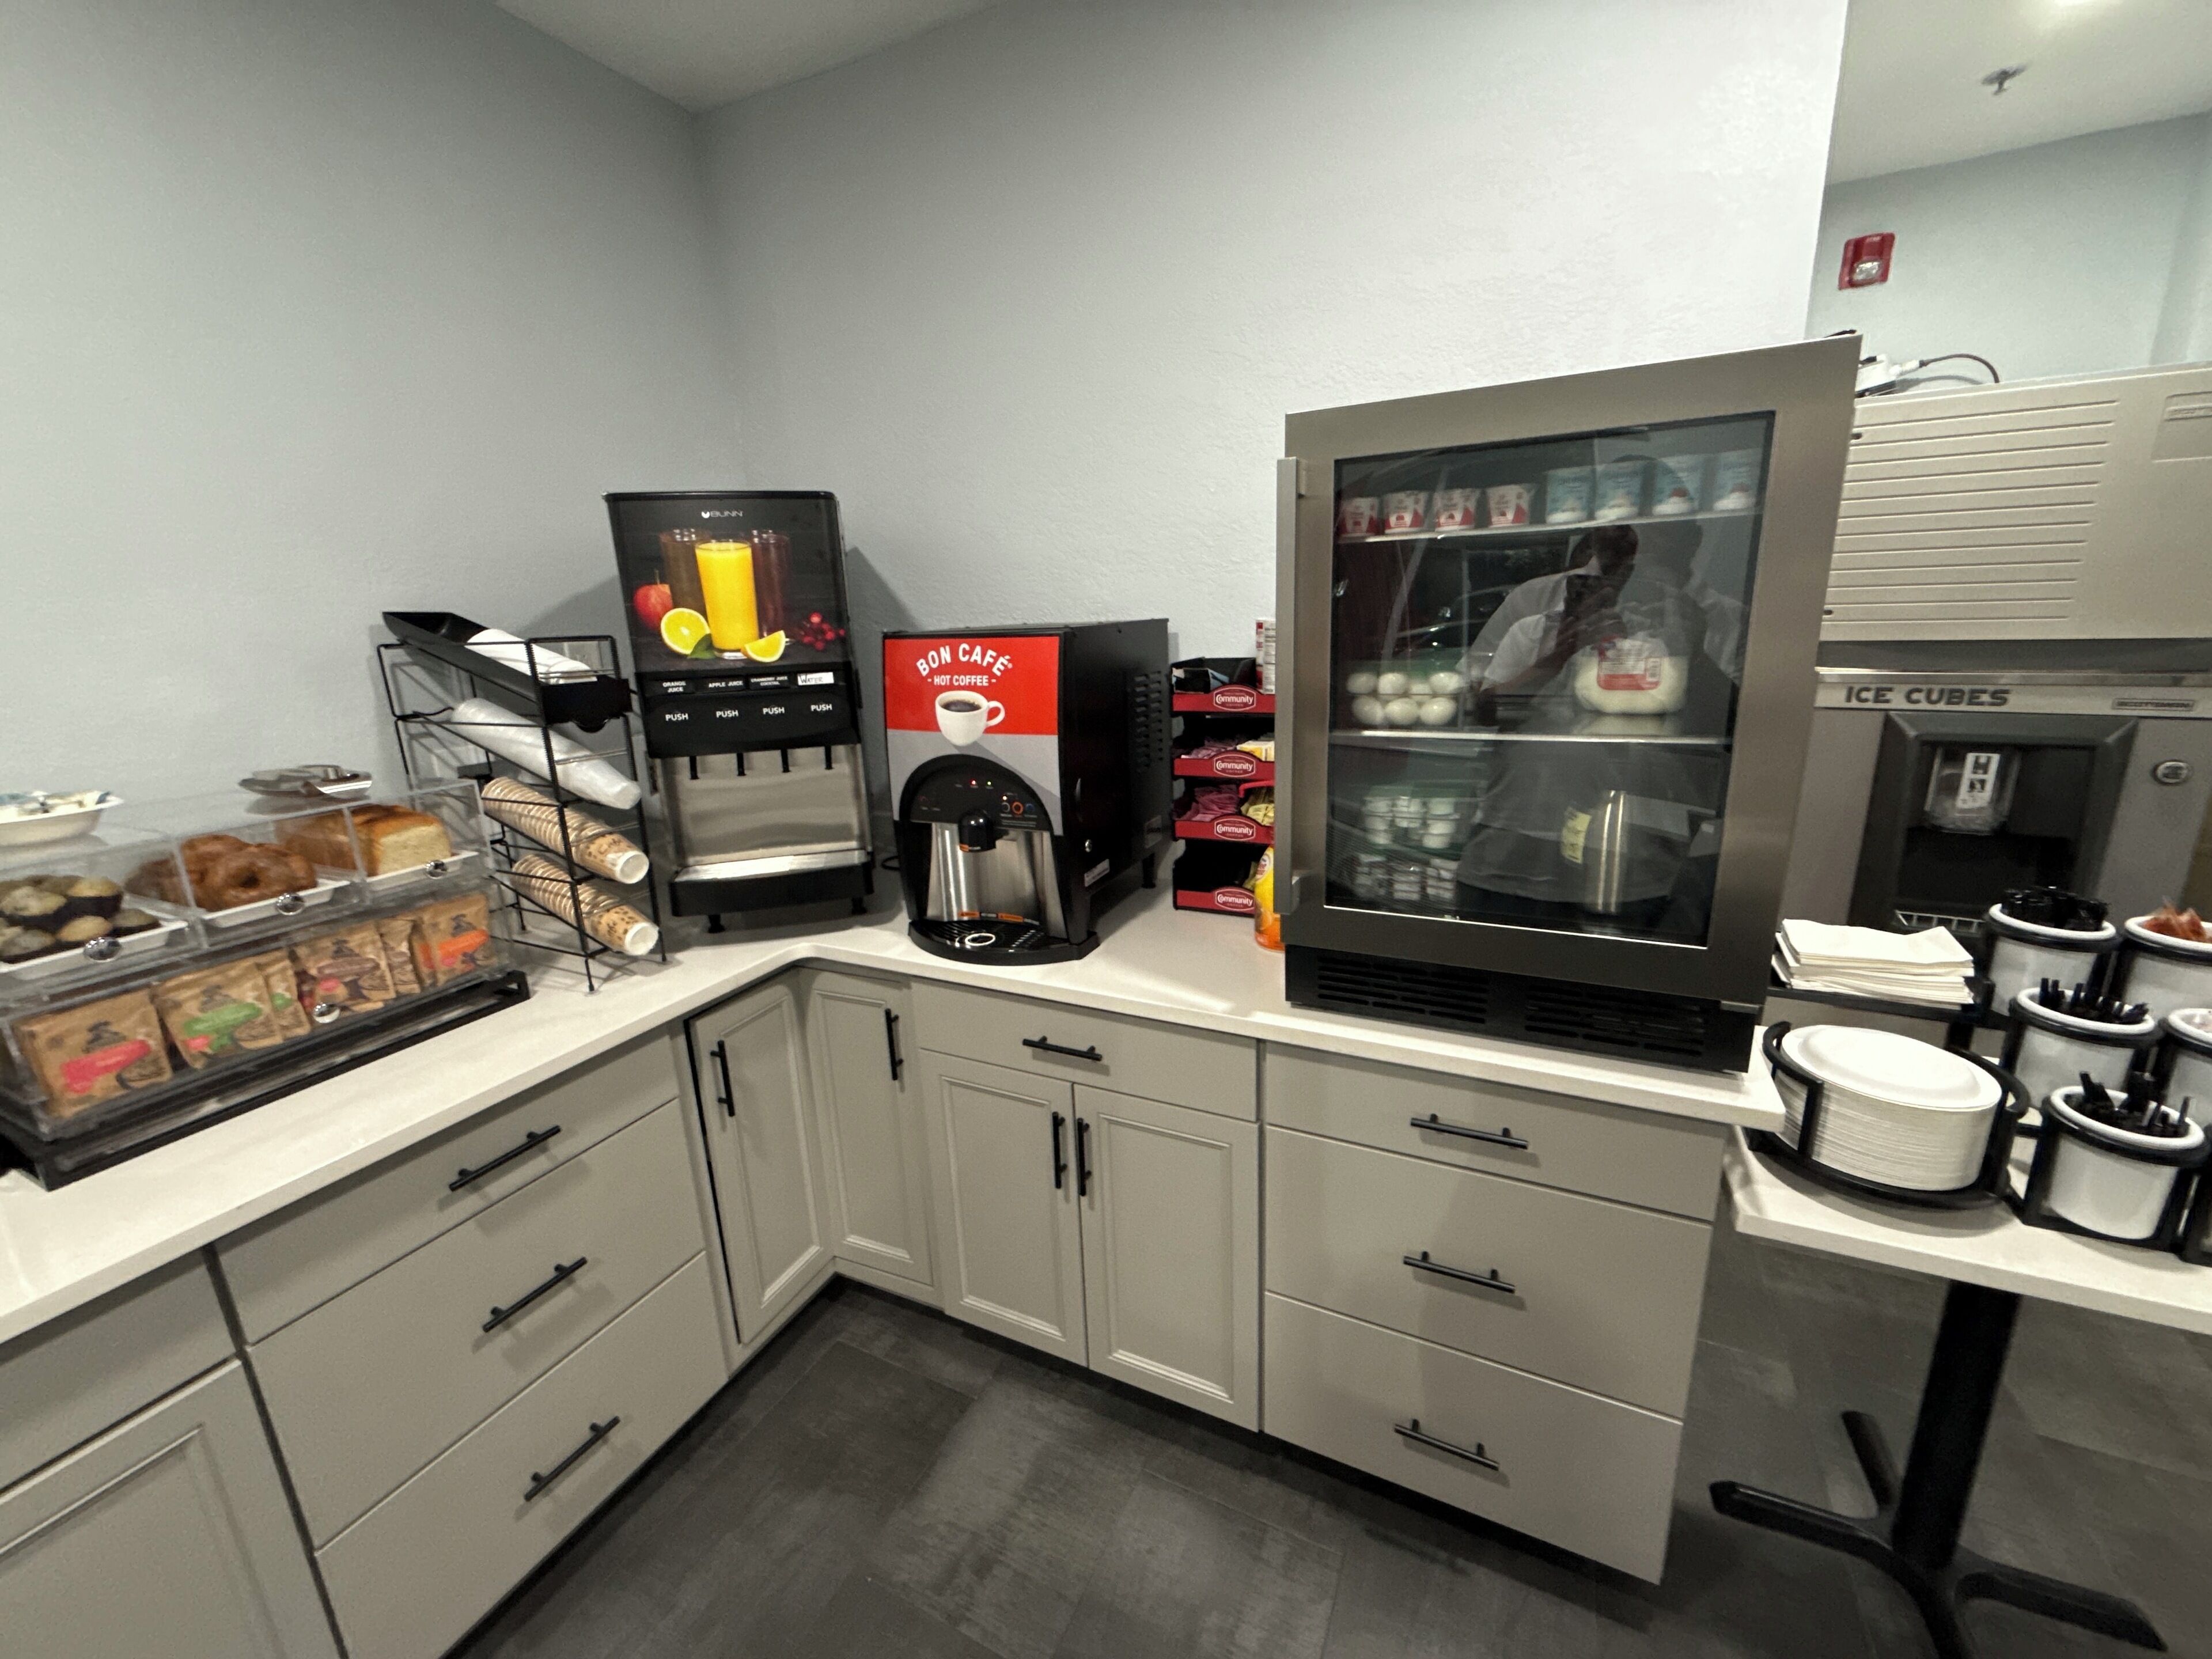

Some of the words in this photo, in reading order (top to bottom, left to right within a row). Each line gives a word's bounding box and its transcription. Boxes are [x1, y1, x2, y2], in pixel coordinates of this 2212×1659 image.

[916, 645, 952, 677] BON
[958, 642, 1011, 677] CAFÉ
[934, 675, 951, 686] HOT
[953, 675, 989, 687] COFFEE
[1215, 694, 1254, 705] Community
[1844, 685, 1895, 704] ICE
[1904, 687, 2012, 707] CUBES
[715, 710, 739, 718] PUSH
[762, 706, 785, 715] PUSH
[810, 704, 833, 712] PUSH
[665, 713, 688, 722] PUSH
[1215, 760, 1253, 772] Community
[1216, 824, 1253, 836] Community
[1217, 893, 1253, 907] Community
